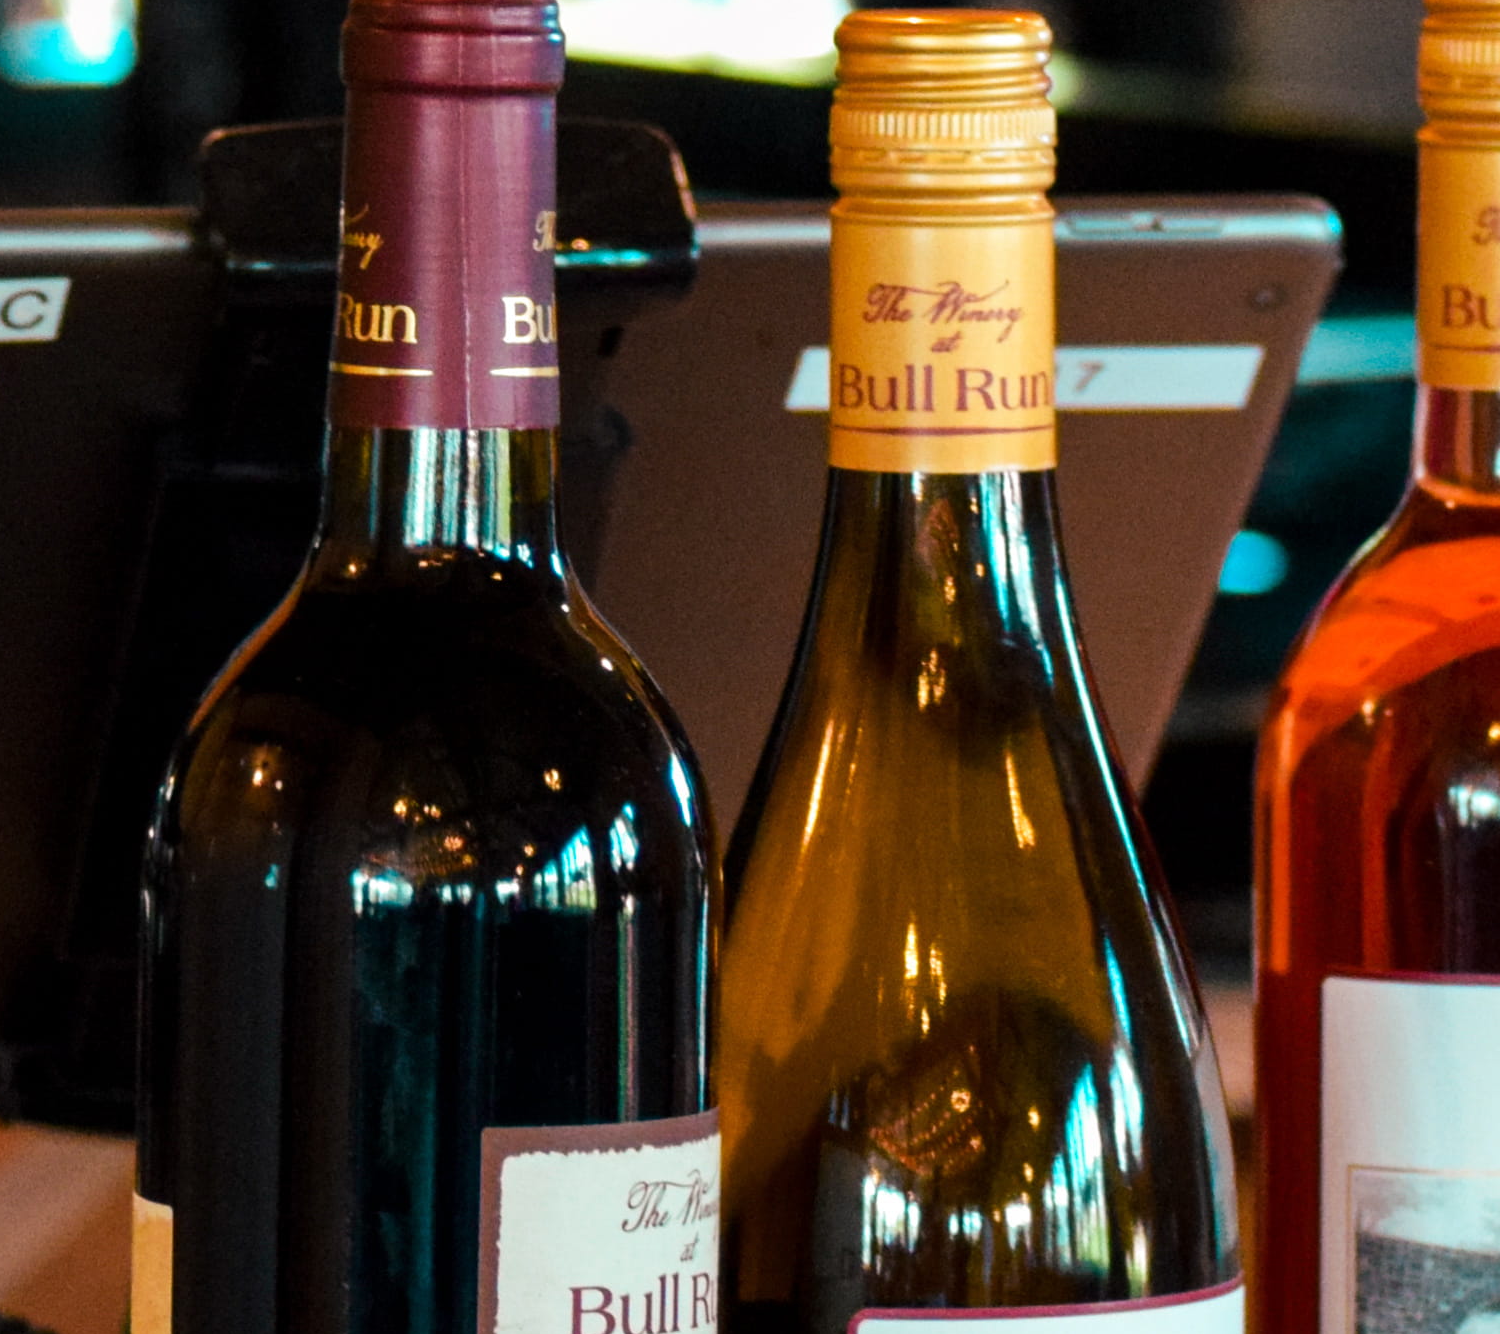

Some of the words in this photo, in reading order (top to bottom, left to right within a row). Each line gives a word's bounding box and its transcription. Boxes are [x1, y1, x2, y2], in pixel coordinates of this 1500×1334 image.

[501, 295, 557, 345] Bu
[862, 283, 913, 325] The
[924, 280, 1025, 343] Winery
[930, 330, 962, 354] at
[837, 363, 934, 413] Bull
[955, 368, 1054, 413] Run
[621, 1179, 671, 1233] The
[680, 1230, 700, 1262] at
[691, 1272, 717, 1329] Ru
